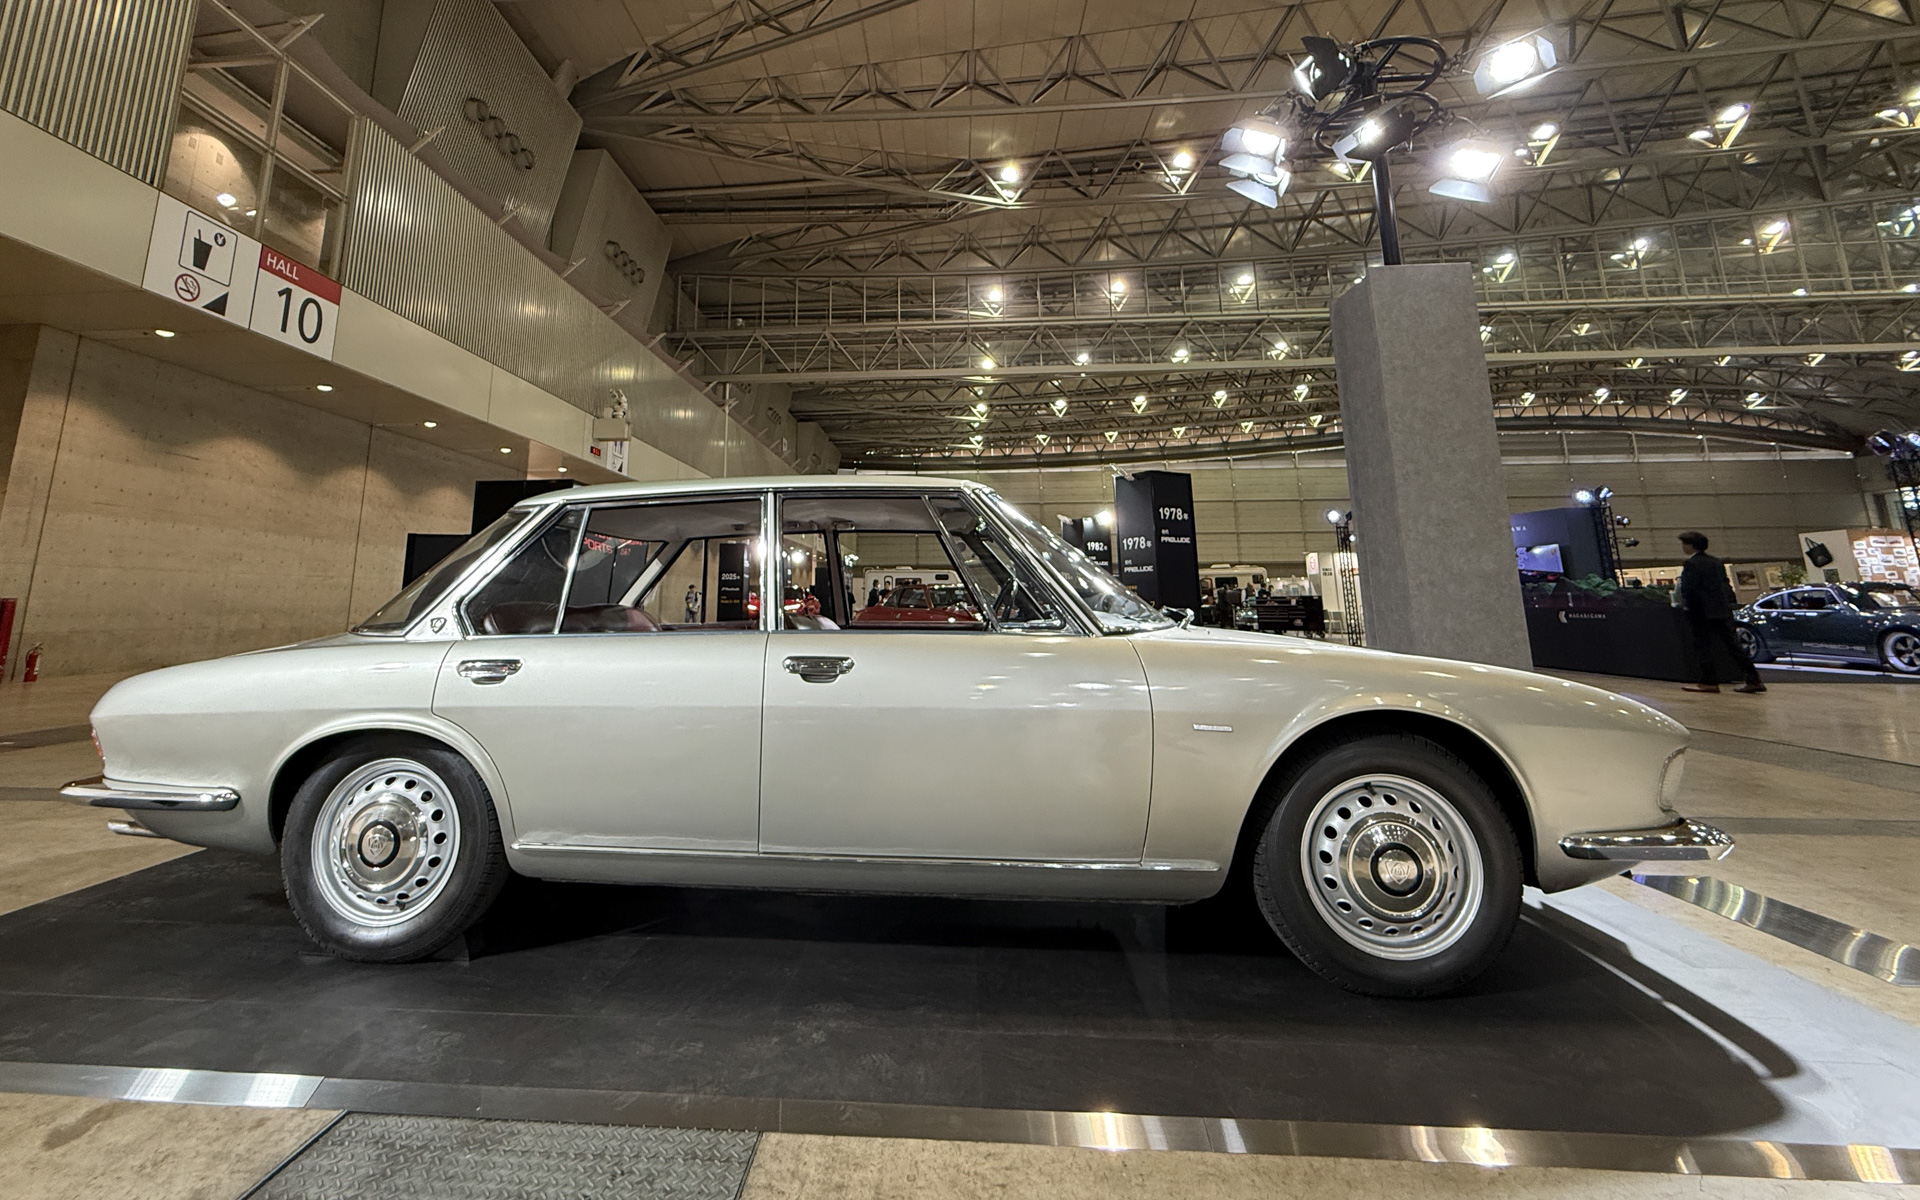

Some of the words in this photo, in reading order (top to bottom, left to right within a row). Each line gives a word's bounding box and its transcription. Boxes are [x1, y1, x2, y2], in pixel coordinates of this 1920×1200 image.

[266, 253, 299, 280] HALL
[277, 286, 323, 344] 10
[1160, 536, 1191, 544] PRELUDE
[1124, 565, 1154, 573] PRELUDE
